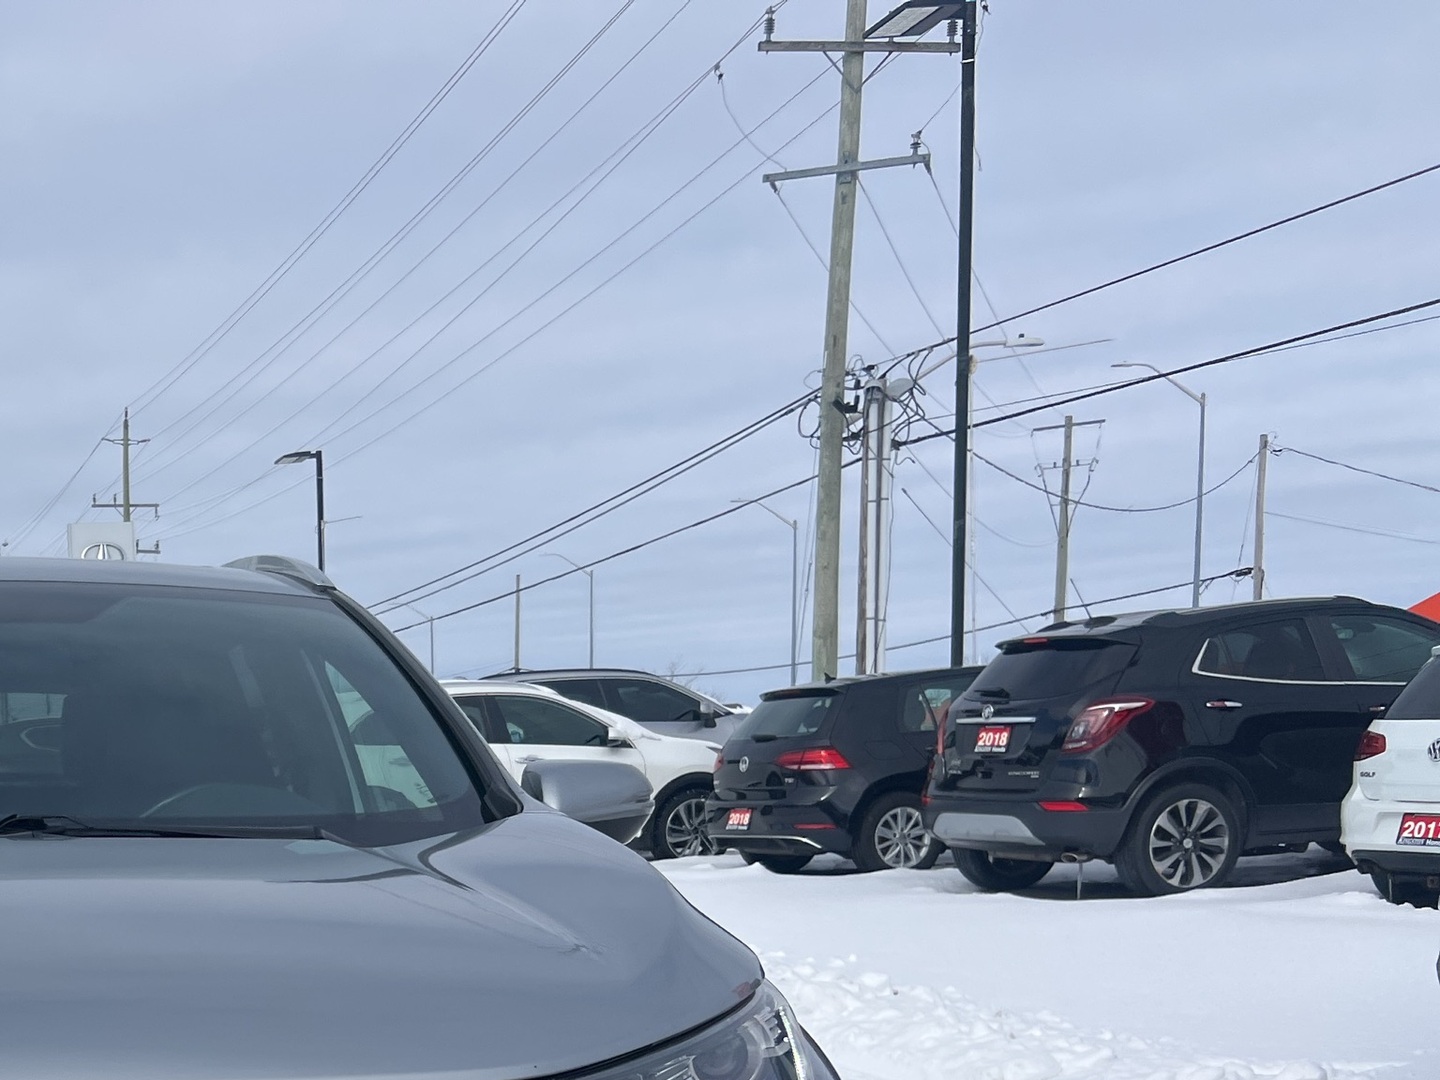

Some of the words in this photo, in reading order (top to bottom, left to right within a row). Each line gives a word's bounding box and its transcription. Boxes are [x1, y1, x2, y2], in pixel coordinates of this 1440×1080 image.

[977, 731, 1008, 746] 2018
[728, 813, 750, 825] 2018
[1401, 821, 1440, 839] 201
